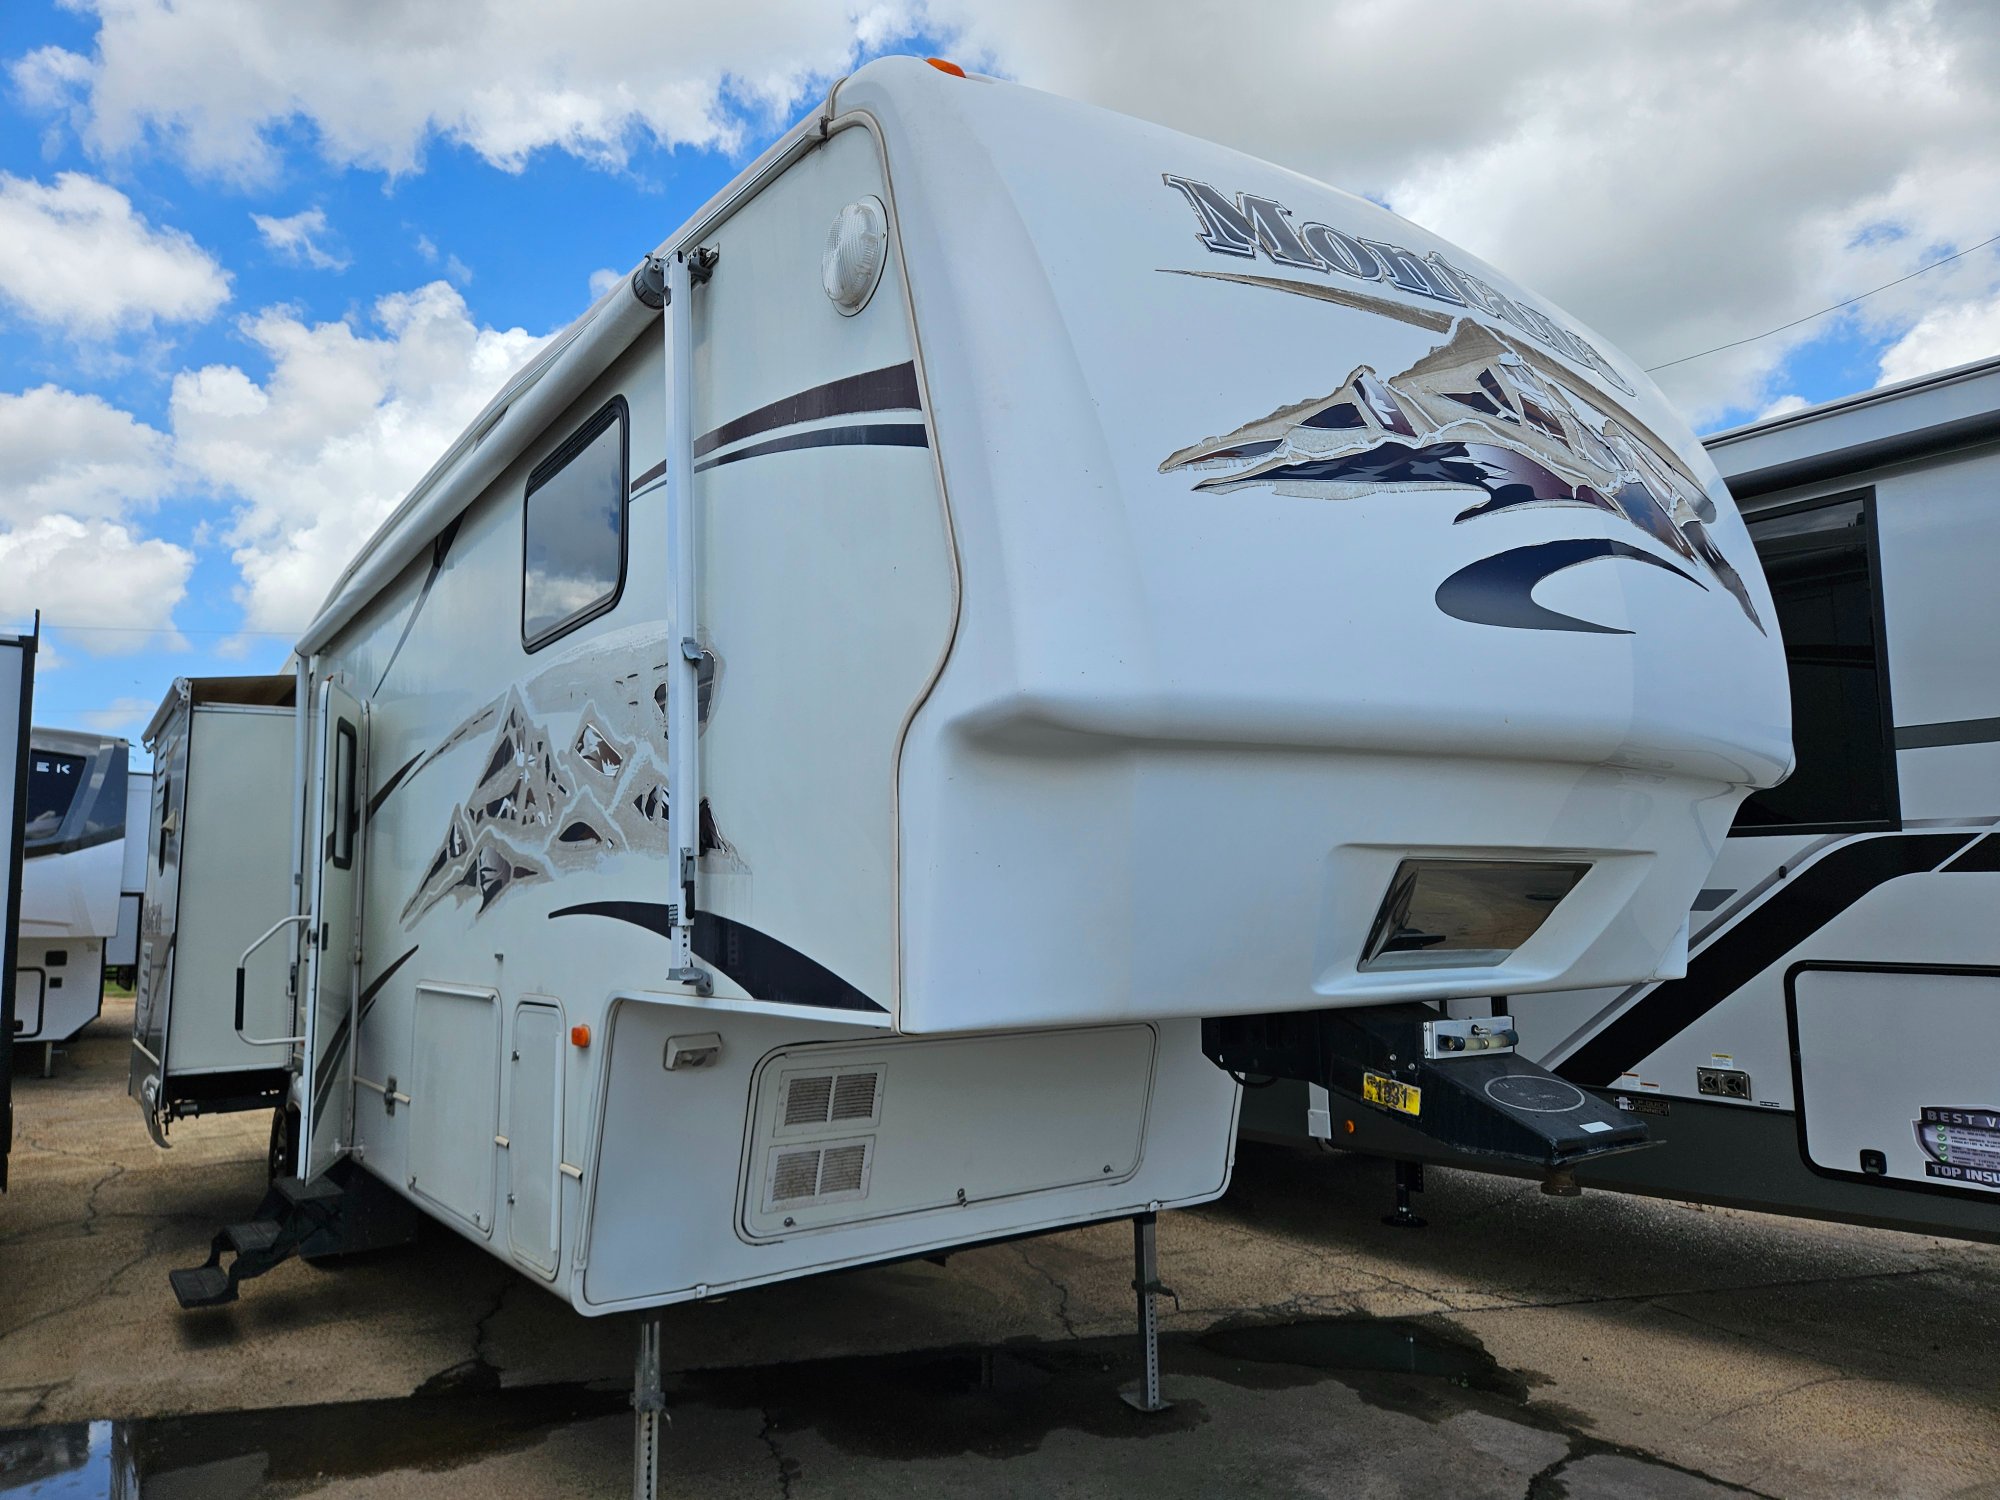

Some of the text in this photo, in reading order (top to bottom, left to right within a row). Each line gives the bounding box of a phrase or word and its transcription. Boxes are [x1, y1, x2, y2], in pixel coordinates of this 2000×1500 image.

[1161, 172, 1636, 398] Montana
[1927, 1110, 2000, 1129] BEST V
[1931, 1164, 1961, 1177] TOP
